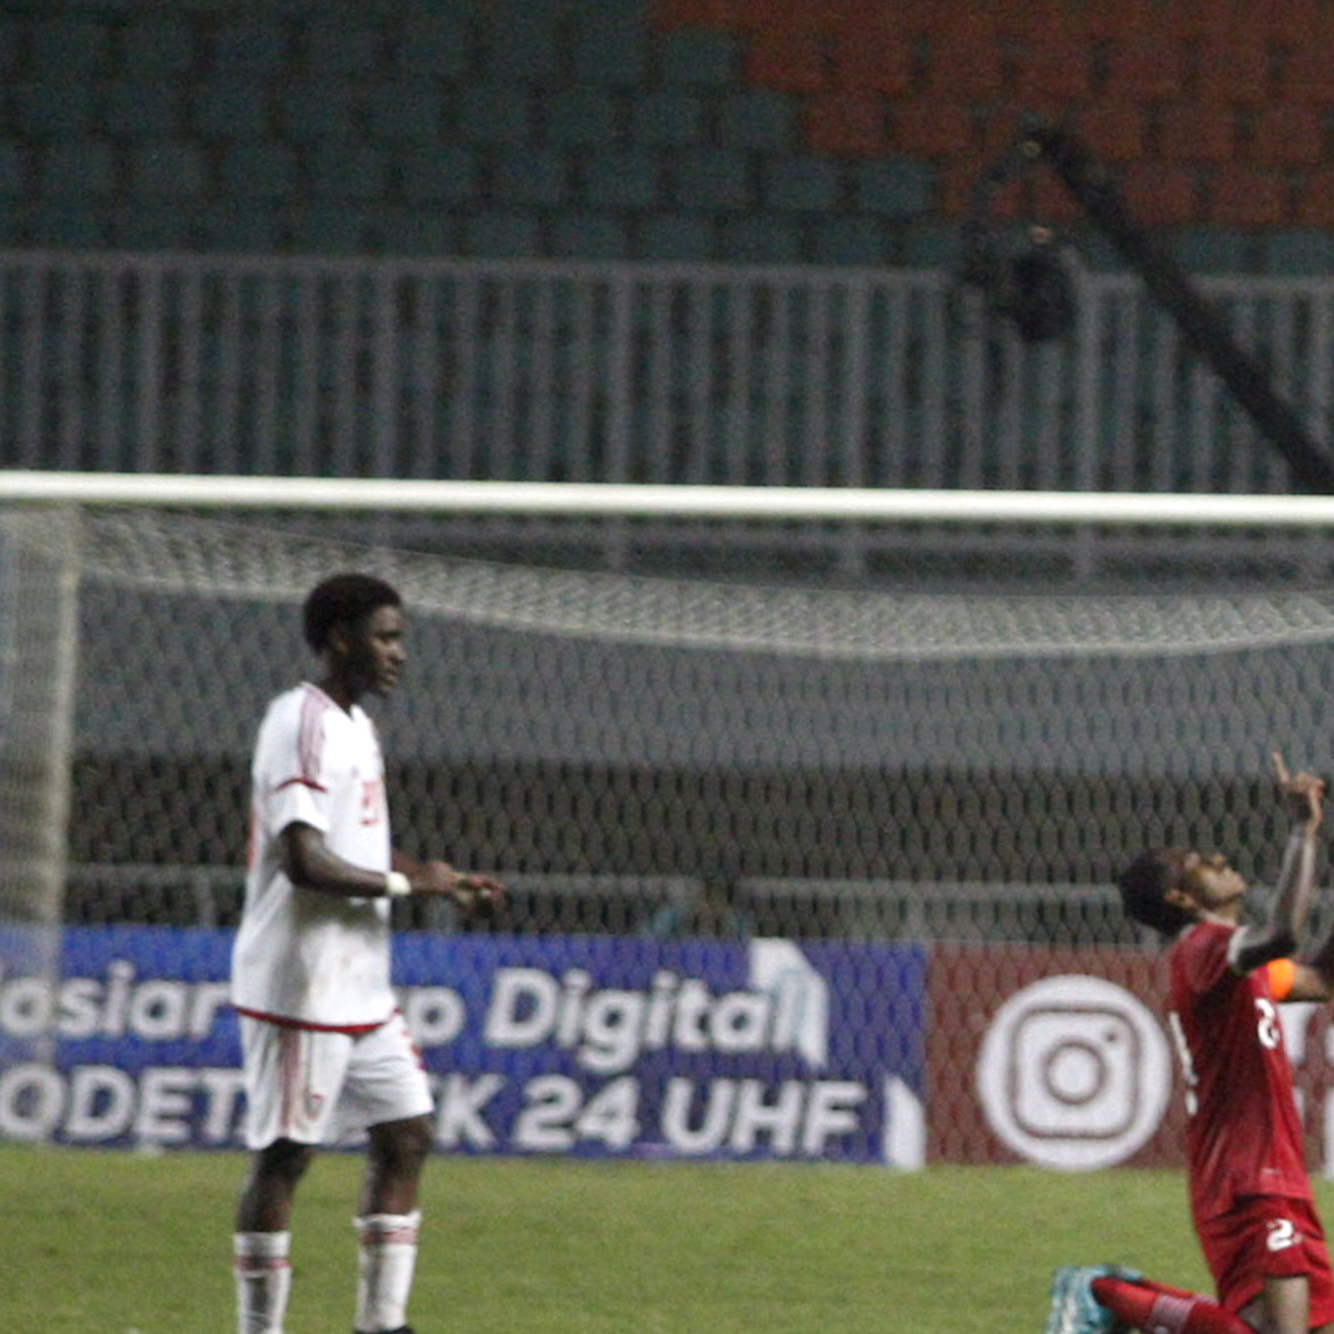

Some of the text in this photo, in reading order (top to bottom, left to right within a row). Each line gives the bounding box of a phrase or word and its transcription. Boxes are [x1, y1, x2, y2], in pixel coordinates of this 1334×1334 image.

[483, 966, 807, 1073] Digital
[513, 1074, 640, 1152] 24
[663, 1078, 867, 1158] UHF
[1266, 1218, 1304, 1252] 2
